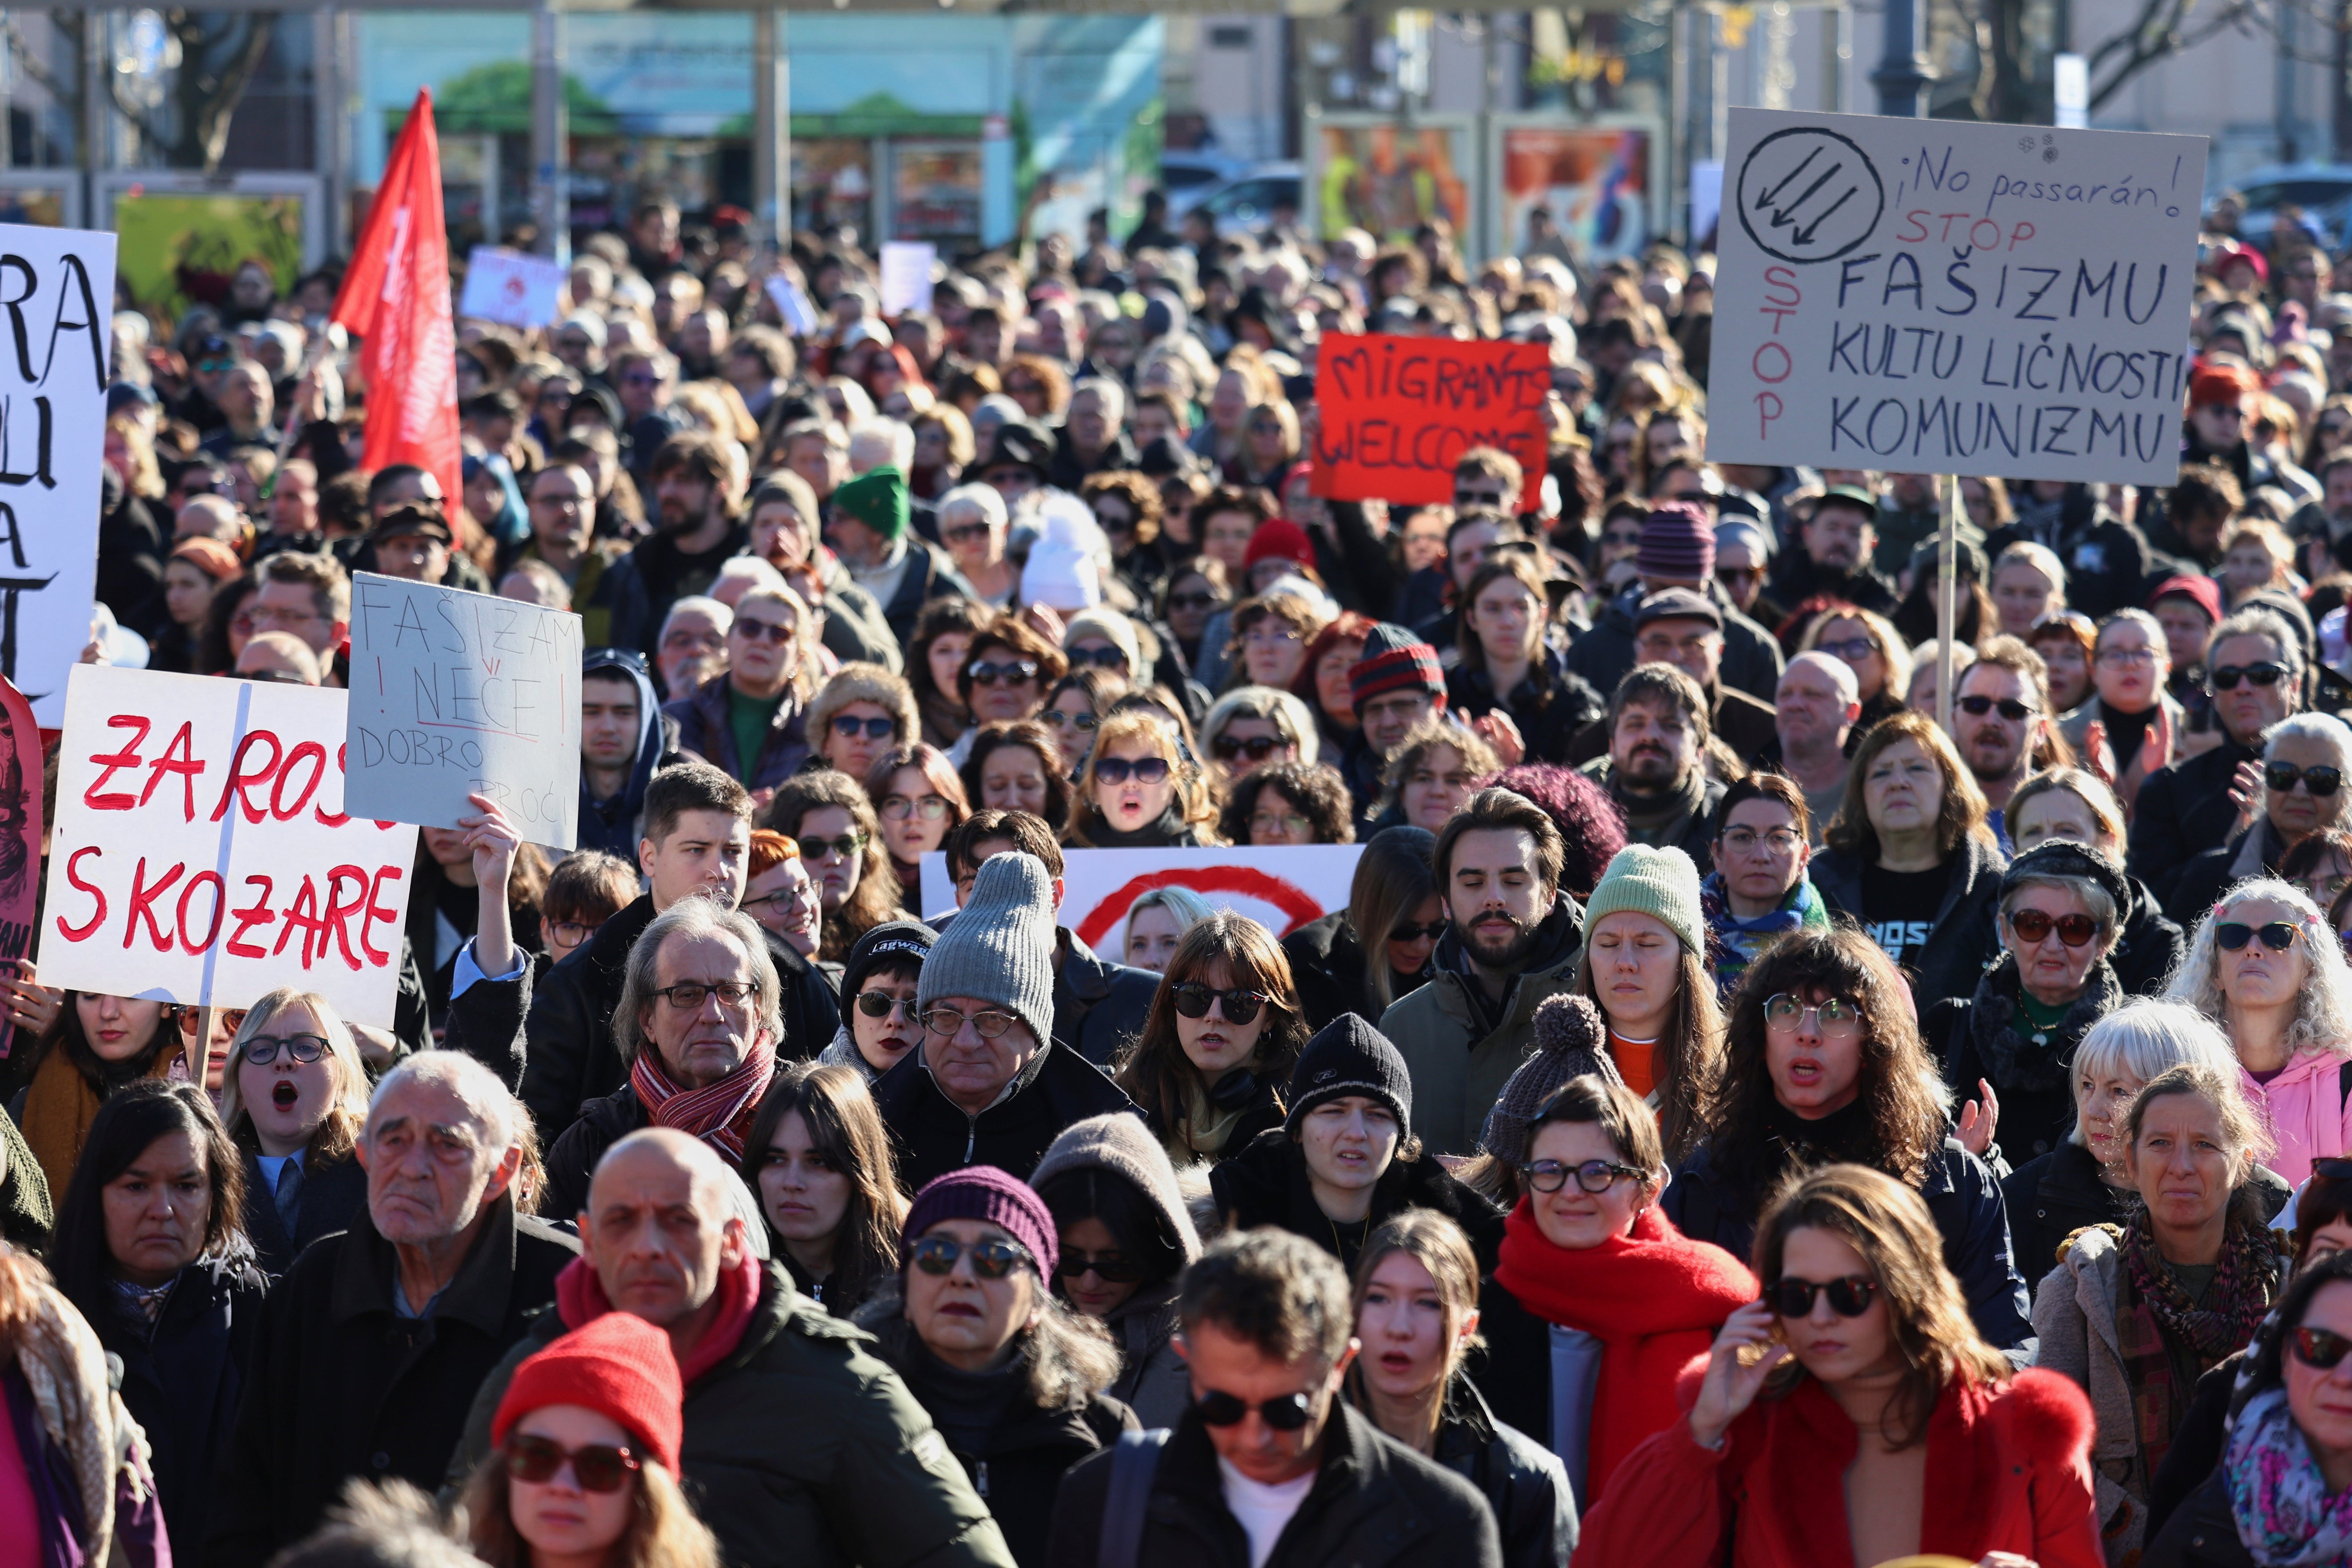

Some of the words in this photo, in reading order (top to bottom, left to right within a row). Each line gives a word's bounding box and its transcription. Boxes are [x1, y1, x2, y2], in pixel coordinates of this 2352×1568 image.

[1896, 210, 2035, 252] STOP
[1838, 245, 2167, 324] FAŠIZMU
[1332, 342, 1551, 419] MIGRANTS
[1829, 320, 1963, 380] KULTU
[1982, 333, 2184, 401] LIČNOSTI
[1832, 395, 2164, 463] KOMUNIZMU
[356, 582, 578, 666] FAŠIZAM
[84, 714, 206, 824] ZA
[358, 727, 483, 771] DOBRO
[57, 846, 107, 943] S
[123, 857, 403, 971] KOZARE
